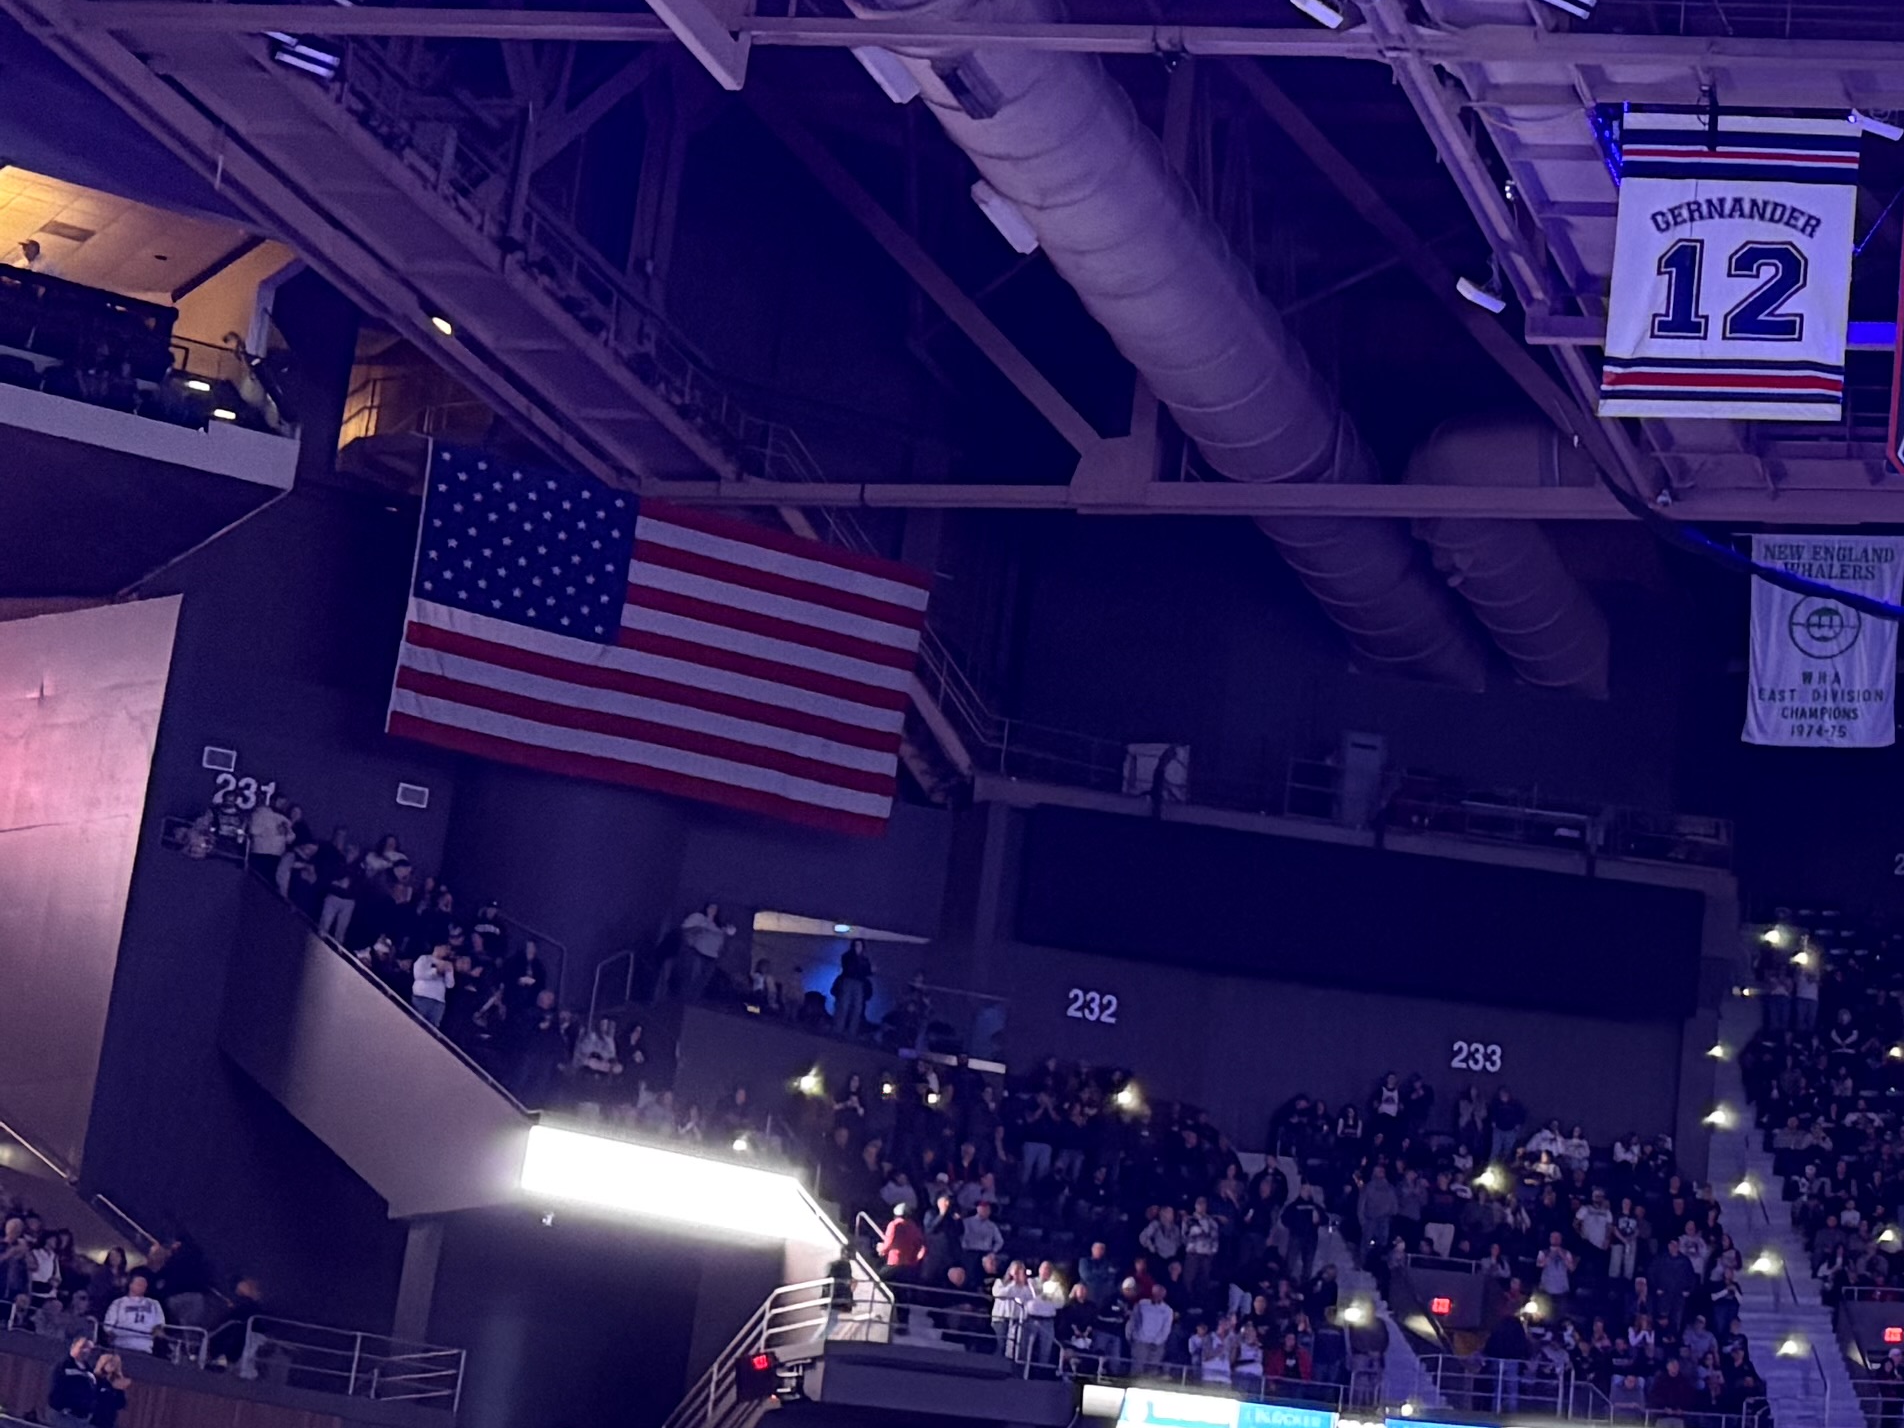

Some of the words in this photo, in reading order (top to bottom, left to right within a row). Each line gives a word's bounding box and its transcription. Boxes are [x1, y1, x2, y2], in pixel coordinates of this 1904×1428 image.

[1650, 195, 1823, 240] GERNANDER
[1649, 237, 1809, 343] 12
[1763, 545, 1809, 563] NEW
[1812, 545, 1895, 564] ENGLAND
[1783, 561, 1877, 581] WHALERS
[1758, 688, 1797, 702] EAST
[1814, 688, 1885, 703] DIVISION
[1781, 706, 1860, 721] CHAMPIONS
[1790, 724, 1847, 739] 1974-75
[213, 772, 276, 810] 231
[1067, 988, 1119, 1024] 232
[1451, 1040, 1503, 1074] 233
